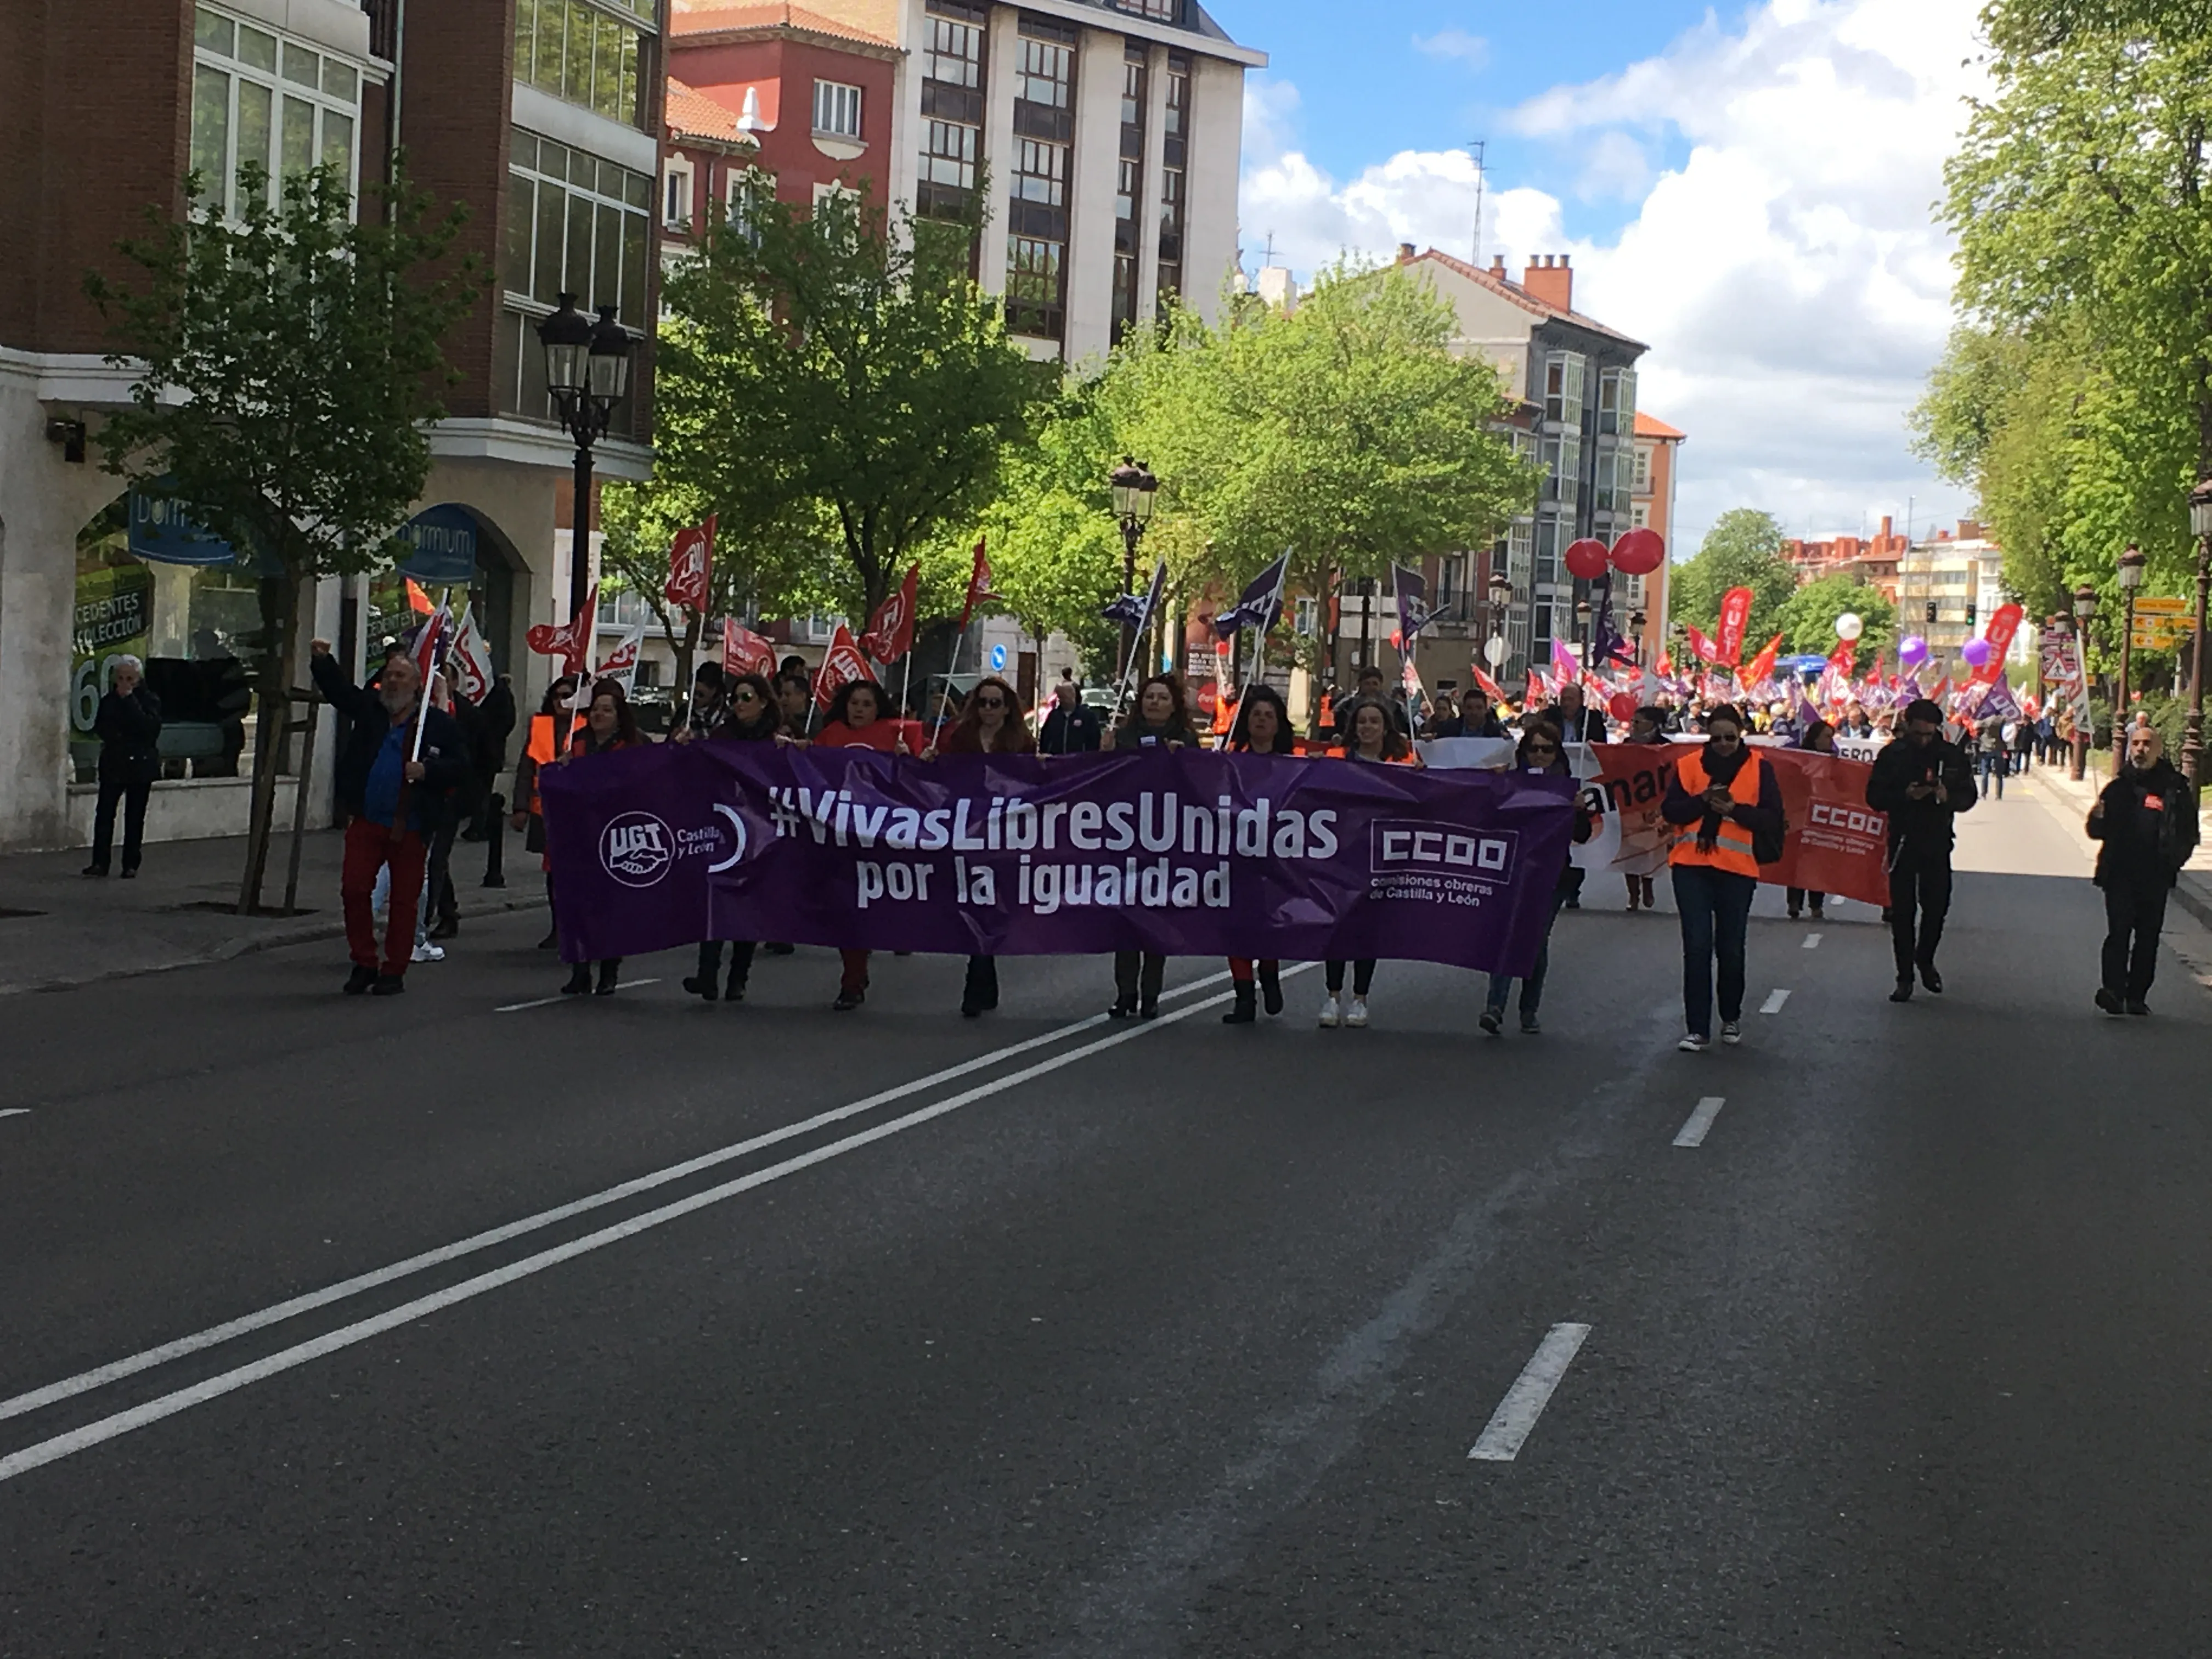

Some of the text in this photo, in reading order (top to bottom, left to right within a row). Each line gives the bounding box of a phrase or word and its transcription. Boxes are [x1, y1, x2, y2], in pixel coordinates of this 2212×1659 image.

[677, 826, 724, 843] Castilla
[769, 786, 1339, 860] #VivasLibresUnidas
[1811, 804, 1883, 836] CCOO
[610, 823, 661, 857] UGT
[678, 841, 715, 860] y León
[1383, 831, 1507, 871] CCOO
[857, 854, 1231, 915] por la igualdad
[1370, 874, 1493, 896] comisiones obreras
[1386, 887, 1433, 900] Castilla
[1436, 892, 1445, 904] y
[1448, 891, 1481, 907] León
